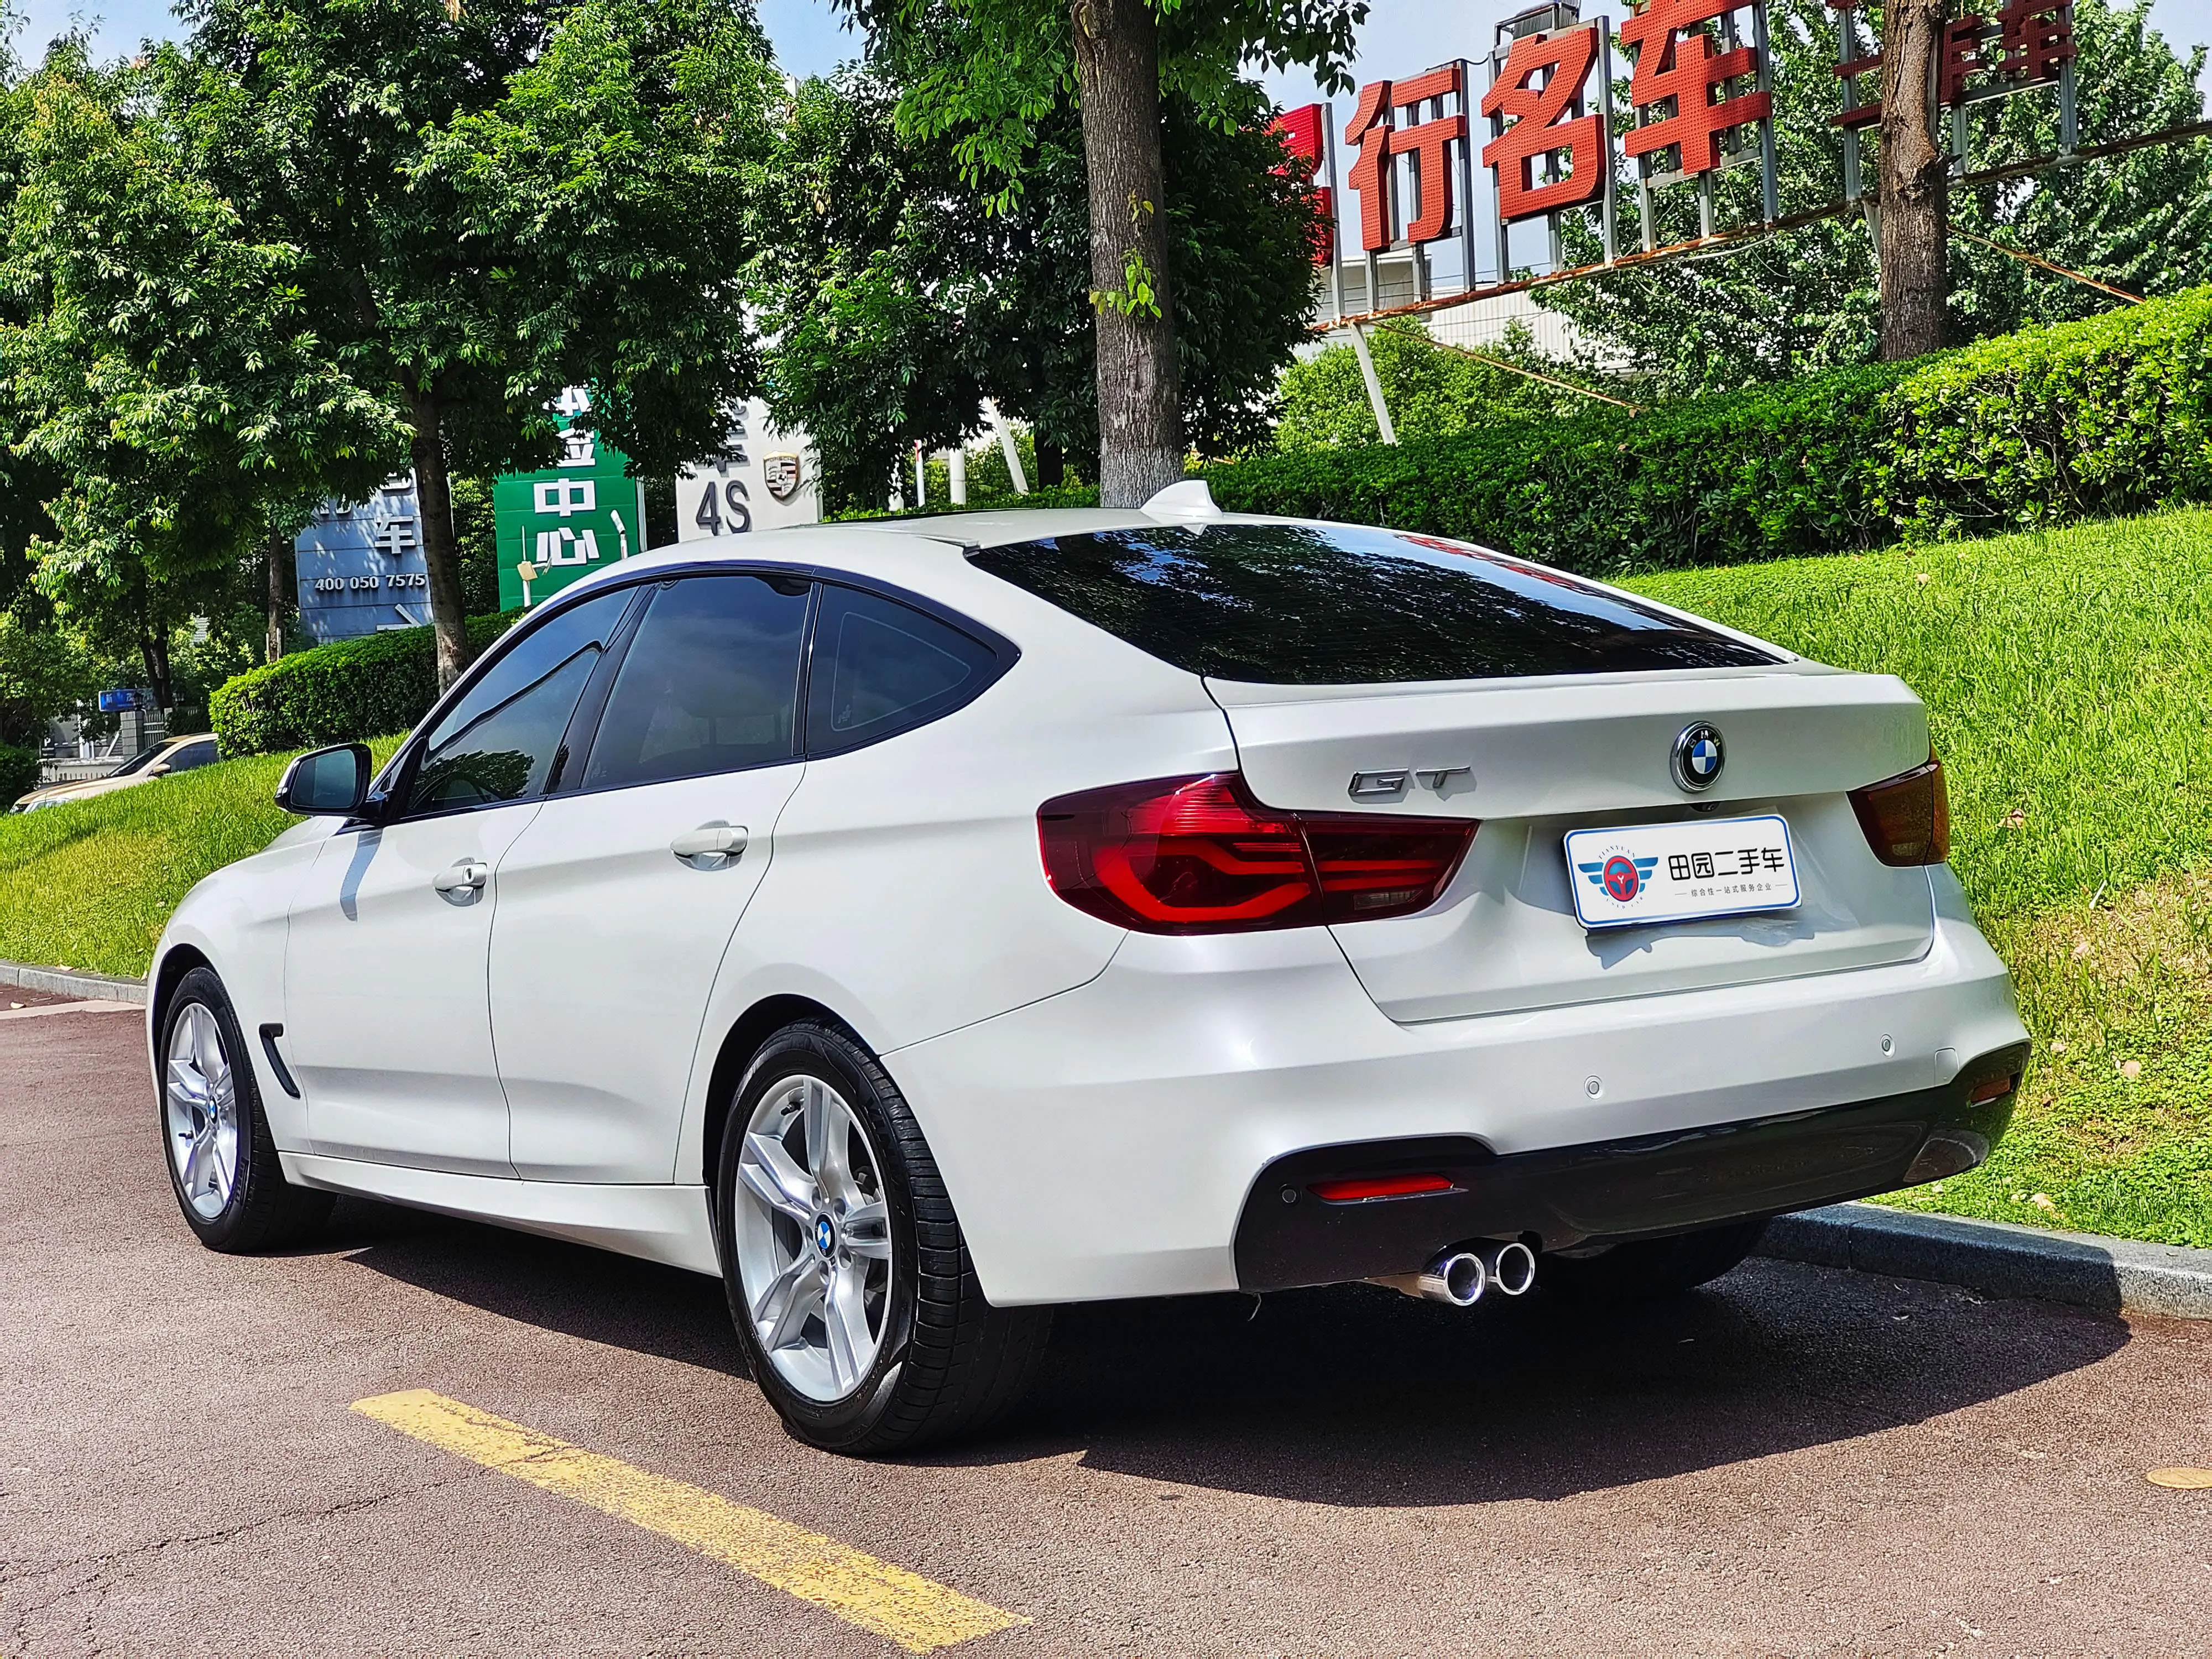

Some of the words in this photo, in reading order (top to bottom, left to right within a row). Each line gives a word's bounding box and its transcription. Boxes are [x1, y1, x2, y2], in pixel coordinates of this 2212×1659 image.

[696, 479, 751, 536] 4S
[315, 578, 345, 590] 400
[349, 576, 379, 588] 050
[386, 573, 425, 587] 7575
[1688, 729, 1721, 748] BMW
[1348, 766, 1471, 796] GT
[1668, 847, 1785, 881] 田园二手车
[1691, 883, 1772, 898] 综合性一站式服务企业
